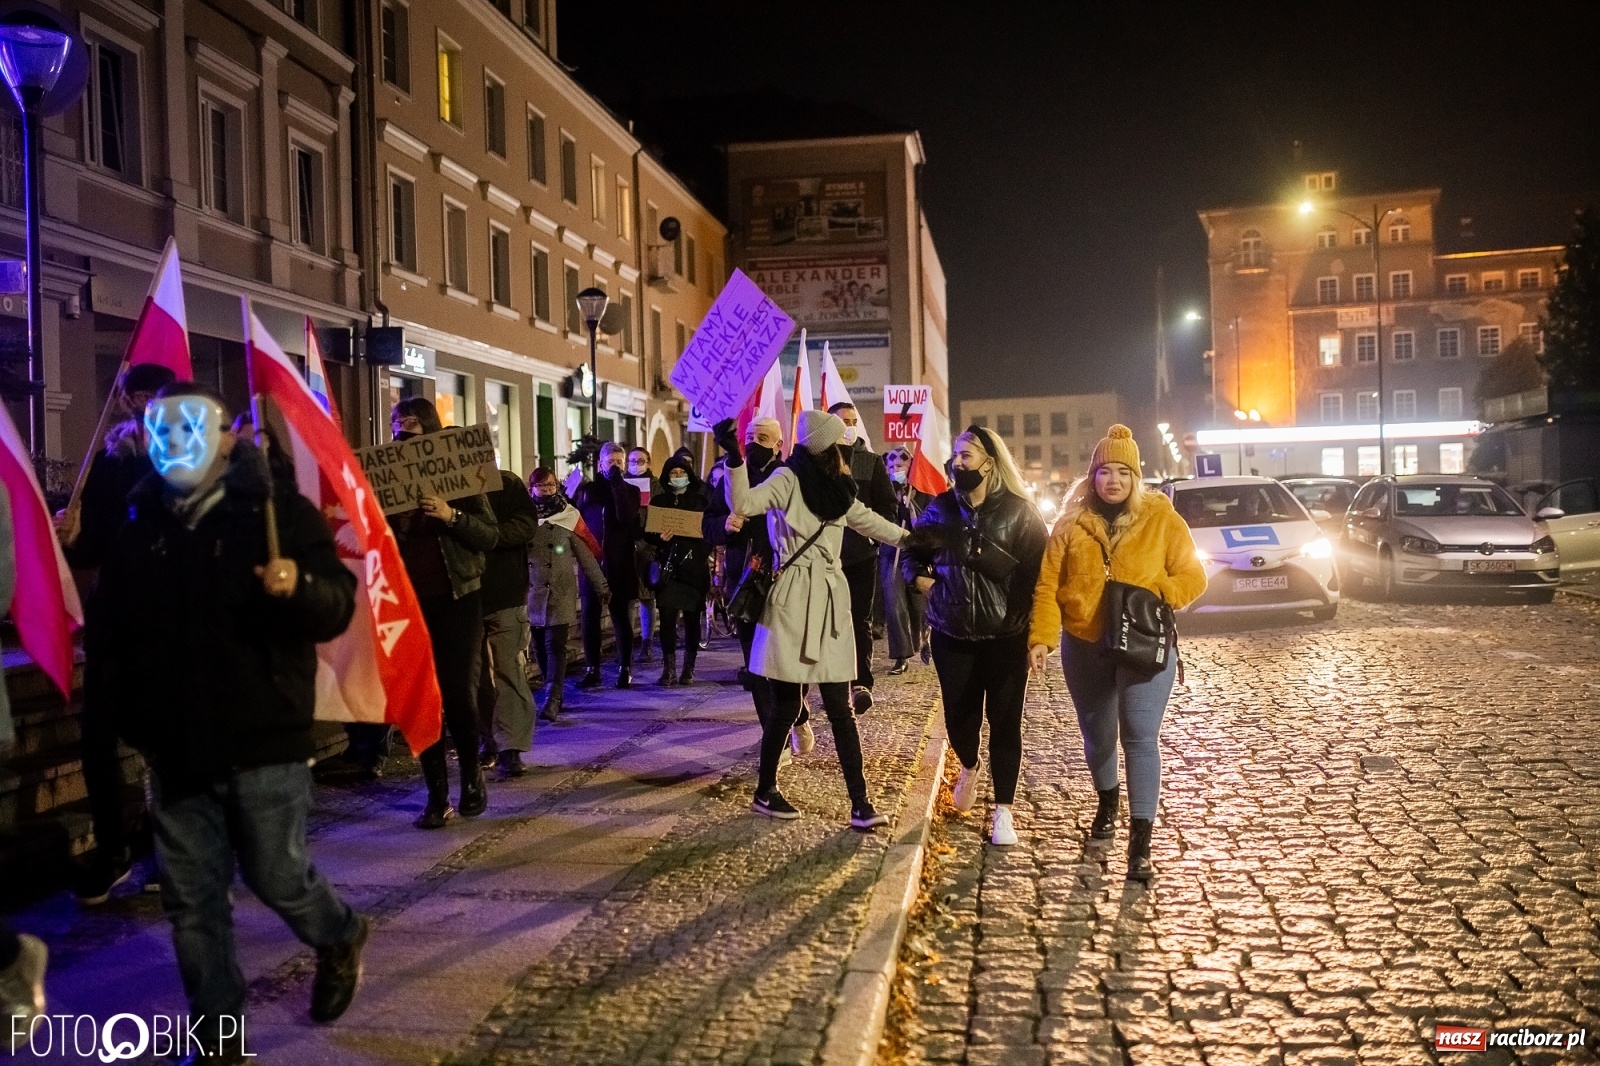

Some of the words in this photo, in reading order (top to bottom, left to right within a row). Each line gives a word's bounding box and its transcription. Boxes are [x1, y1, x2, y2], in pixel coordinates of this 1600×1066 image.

[756, 267, 881, 283] ALEXANDER
[746, 296, 773, 334] JEST
[672, 304, 724, 385] WITAMY
[686, 375, 701, 396] W
[701, 303, 749, 375] PIEKLE
[709, 382, 738, 420] JAK
[734, 316, 788, 387] ZARAZA
[888, 389, 928, 405] WOLNA
[409, 439, 435, 458] TO
[440, 428, 493, 452] TWOJA
[888, 421, 920, 439] POLK
[402, 457, 456, 480] TWOJA
[1203, 458, 1216, 475] L
[373, 483, 424, 509] IELKA
[431, 474, 471, 495] WINA
[1238, 578, 1259, 589] SRC
[1260, 576, 1286, 588] EE44
